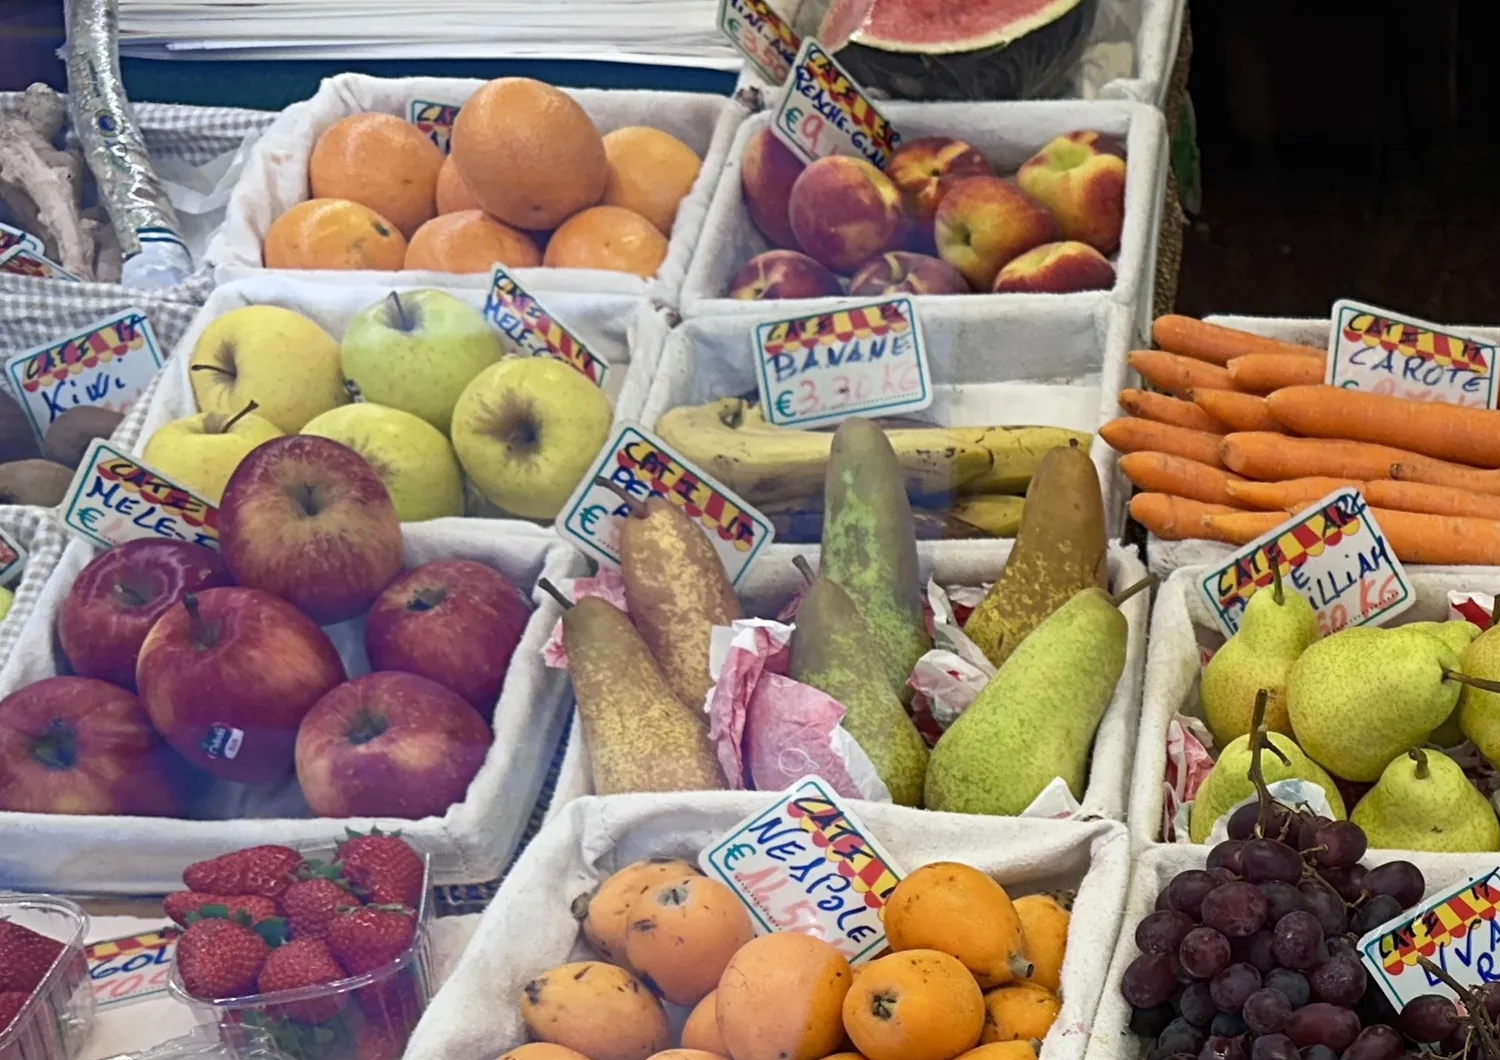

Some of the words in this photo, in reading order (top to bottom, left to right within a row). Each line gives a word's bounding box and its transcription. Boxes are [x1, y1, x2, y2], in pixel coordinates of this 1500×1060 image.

[768, 331, 912, 383] BANANE
[1349, 346, 1489, 393] CAROTE
[579, 505, 609, 536] €
[723, 843, 757, 871] €
[748, 817, 877, 944] NESPOLE
